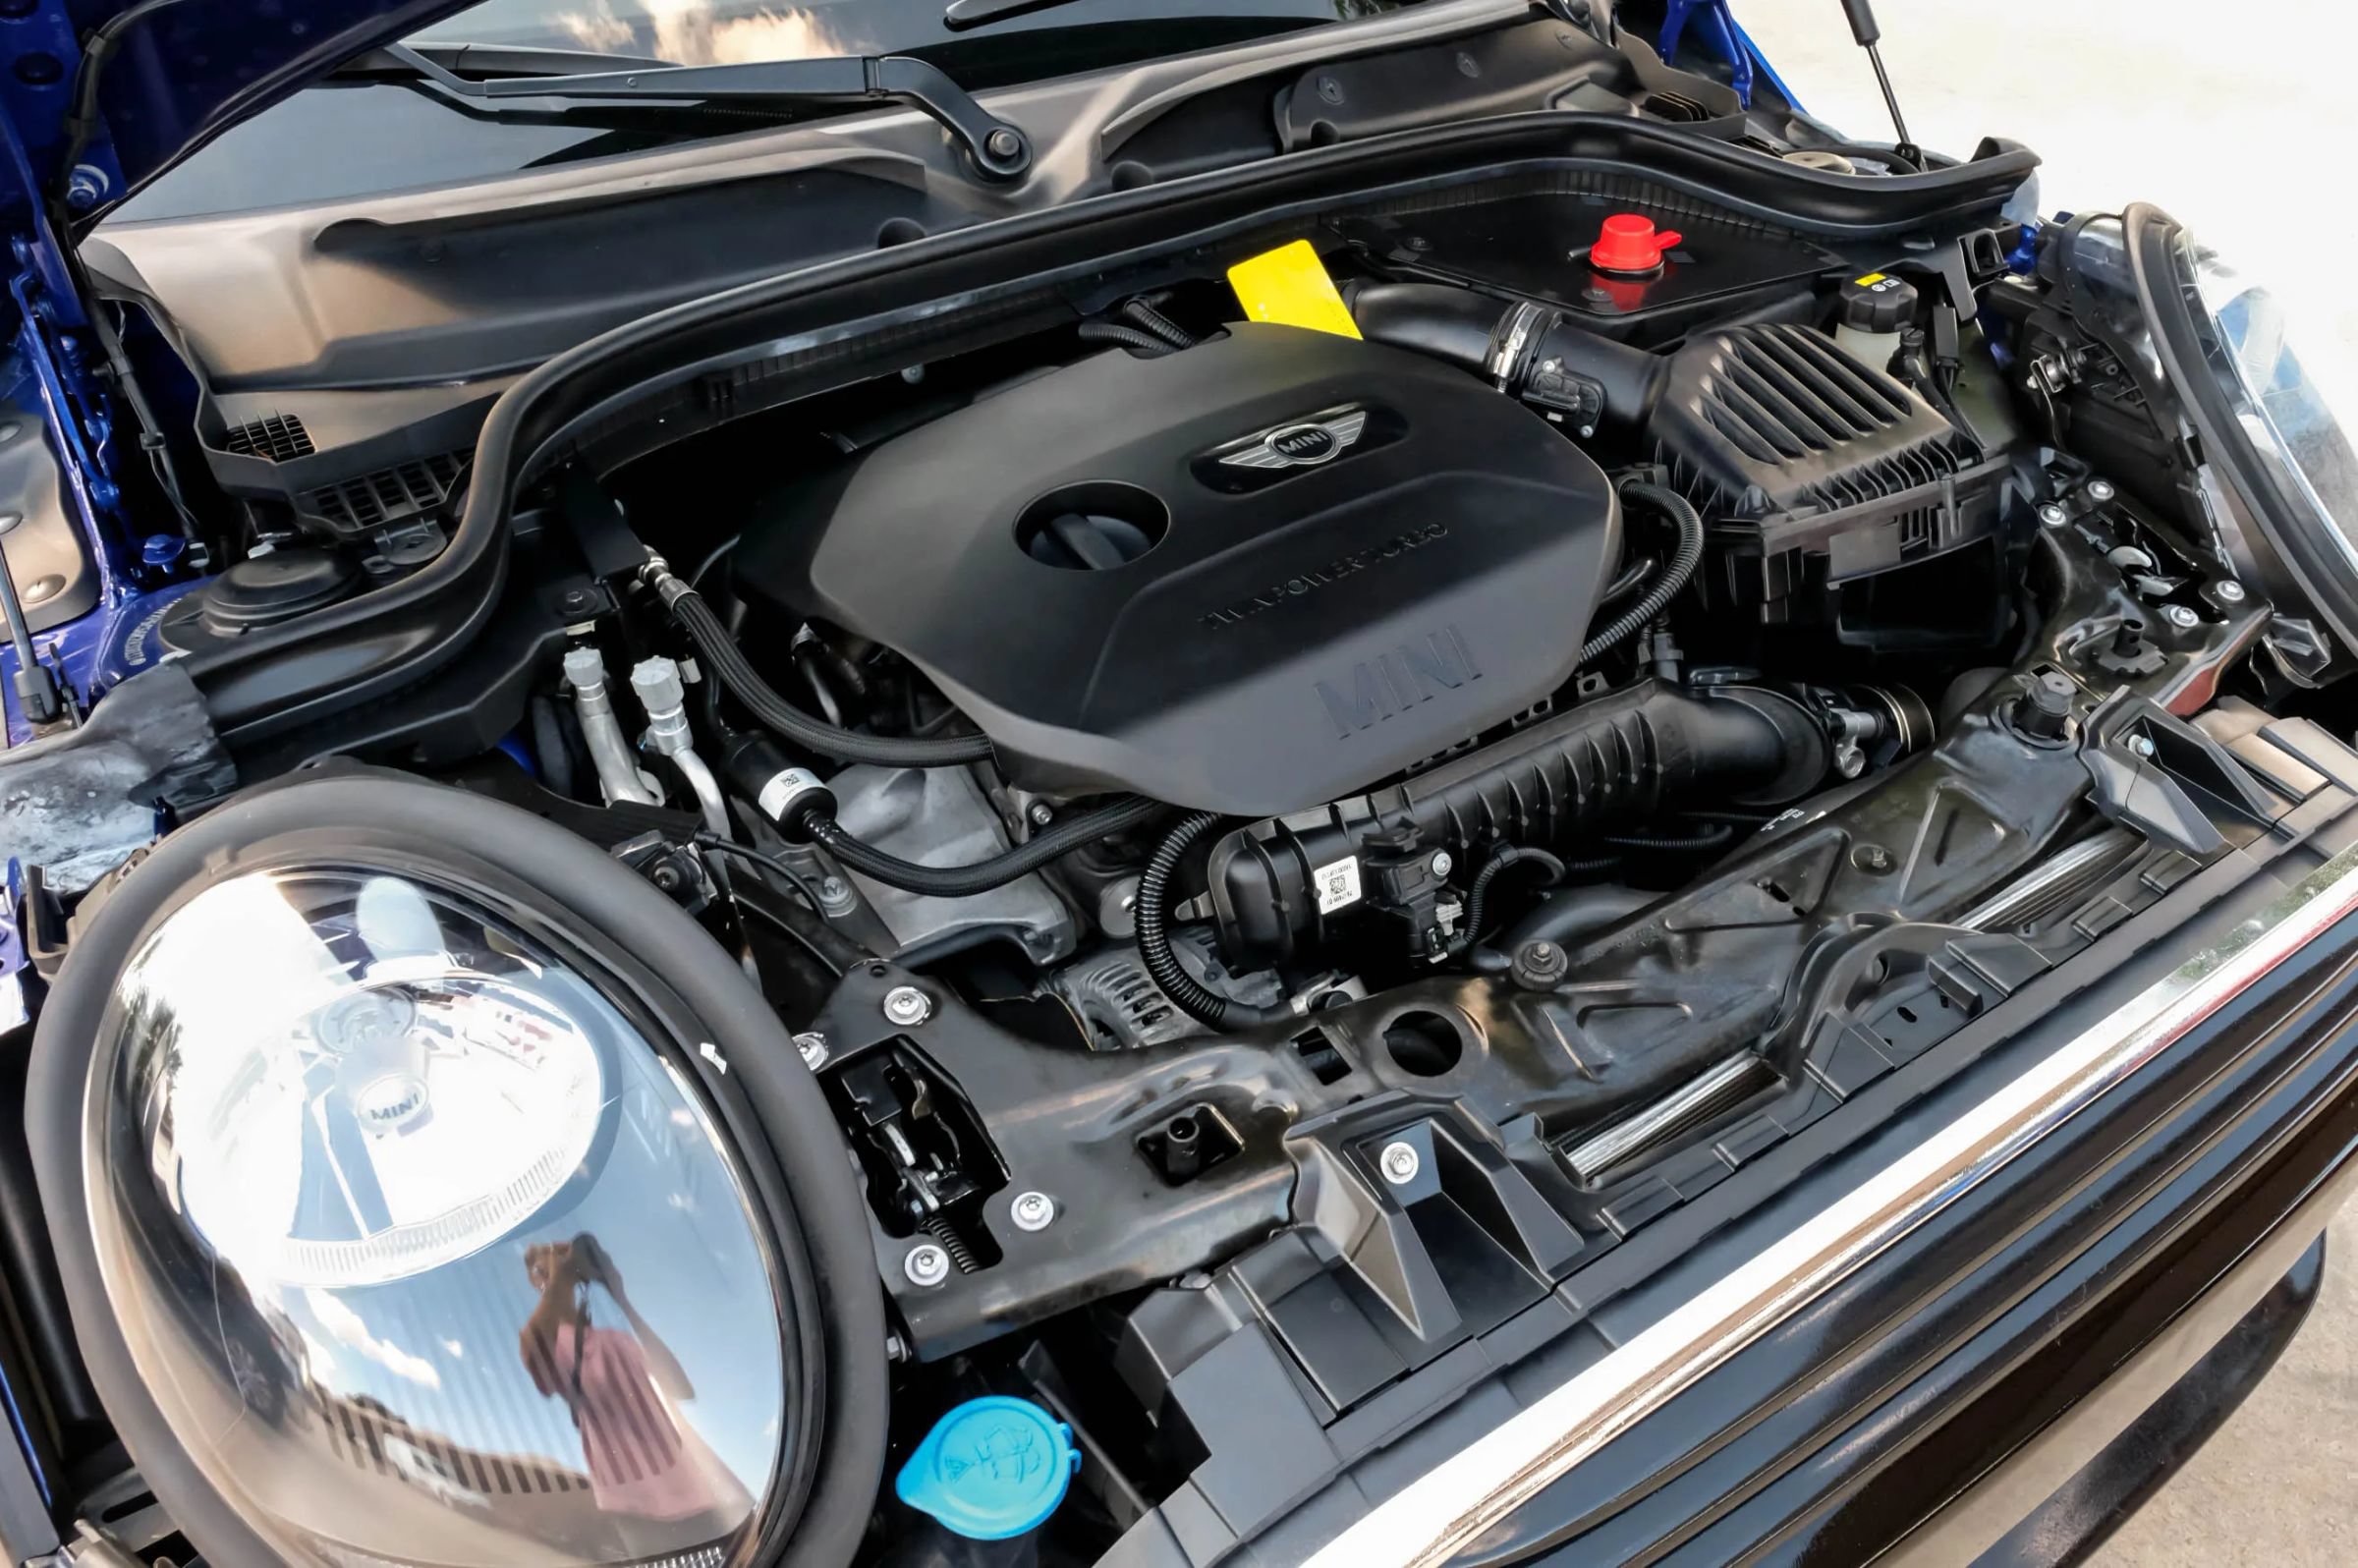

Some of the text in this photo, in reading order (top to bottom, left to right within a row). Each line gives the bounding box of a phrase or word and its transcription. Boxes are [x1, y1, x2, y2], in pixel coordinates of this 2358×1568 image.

[1277, 431, 1329, 454] MINI
[1313, 622, 1484, 741] MINI
[369, 1092, 420, 1120] MINI
